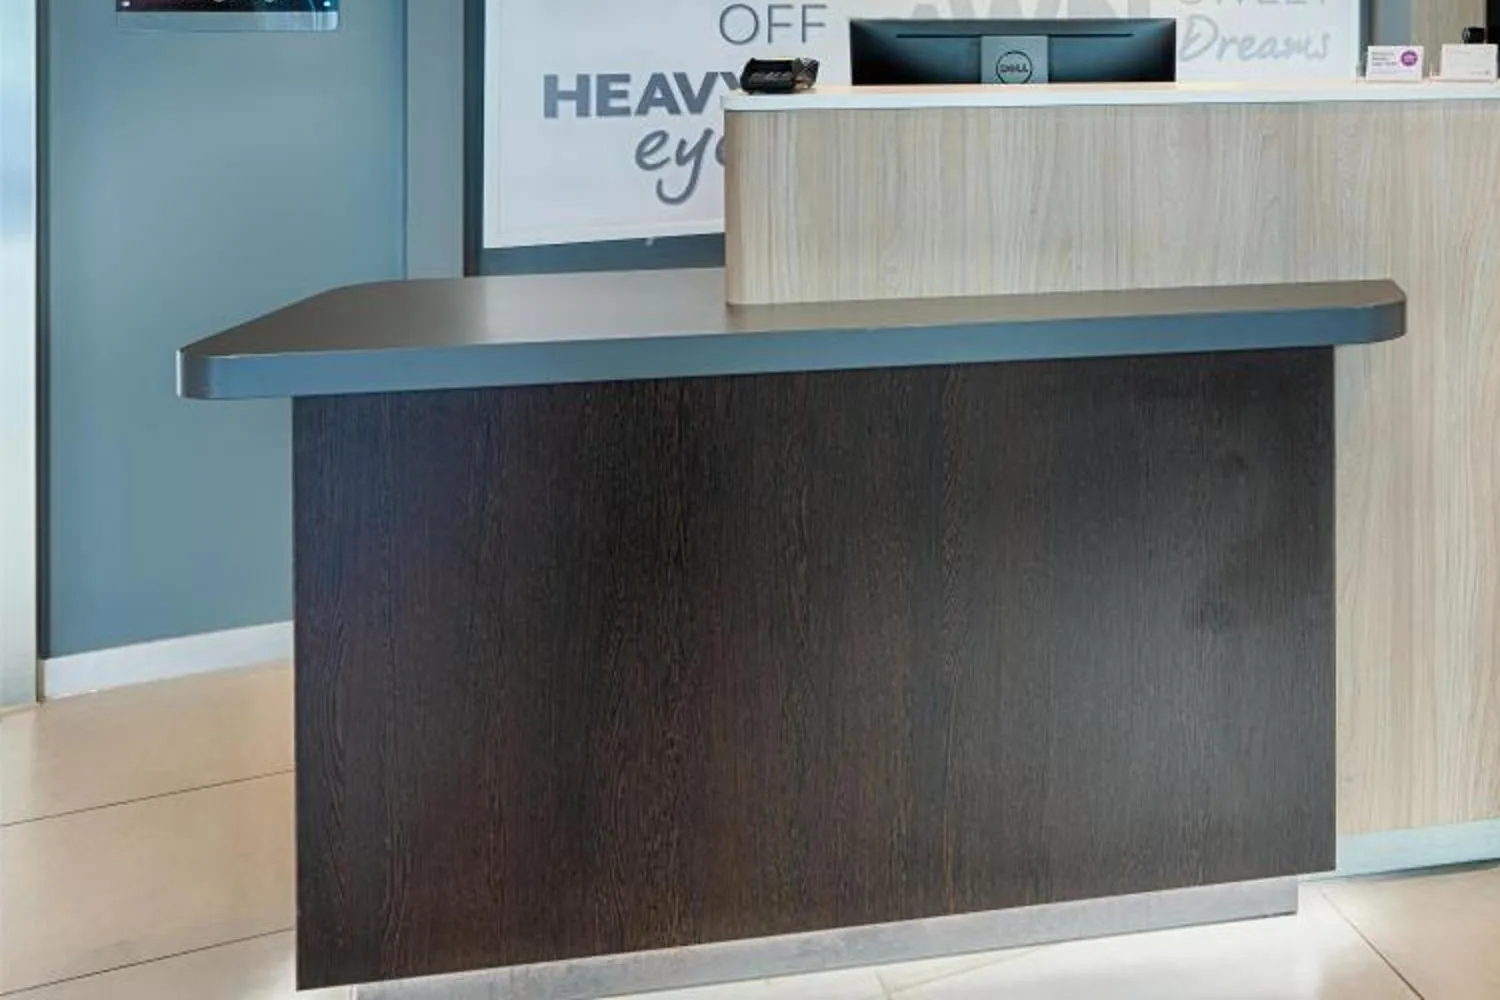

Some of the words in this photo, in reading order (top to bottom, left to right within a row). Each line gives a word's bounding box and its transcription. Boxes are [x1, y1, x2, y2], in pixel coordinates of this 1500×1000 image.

[719, 3, 828, 46] OFF
[1179, 13, 1331, 63] Dreams
[543, 71, 740, 119] HEAV
